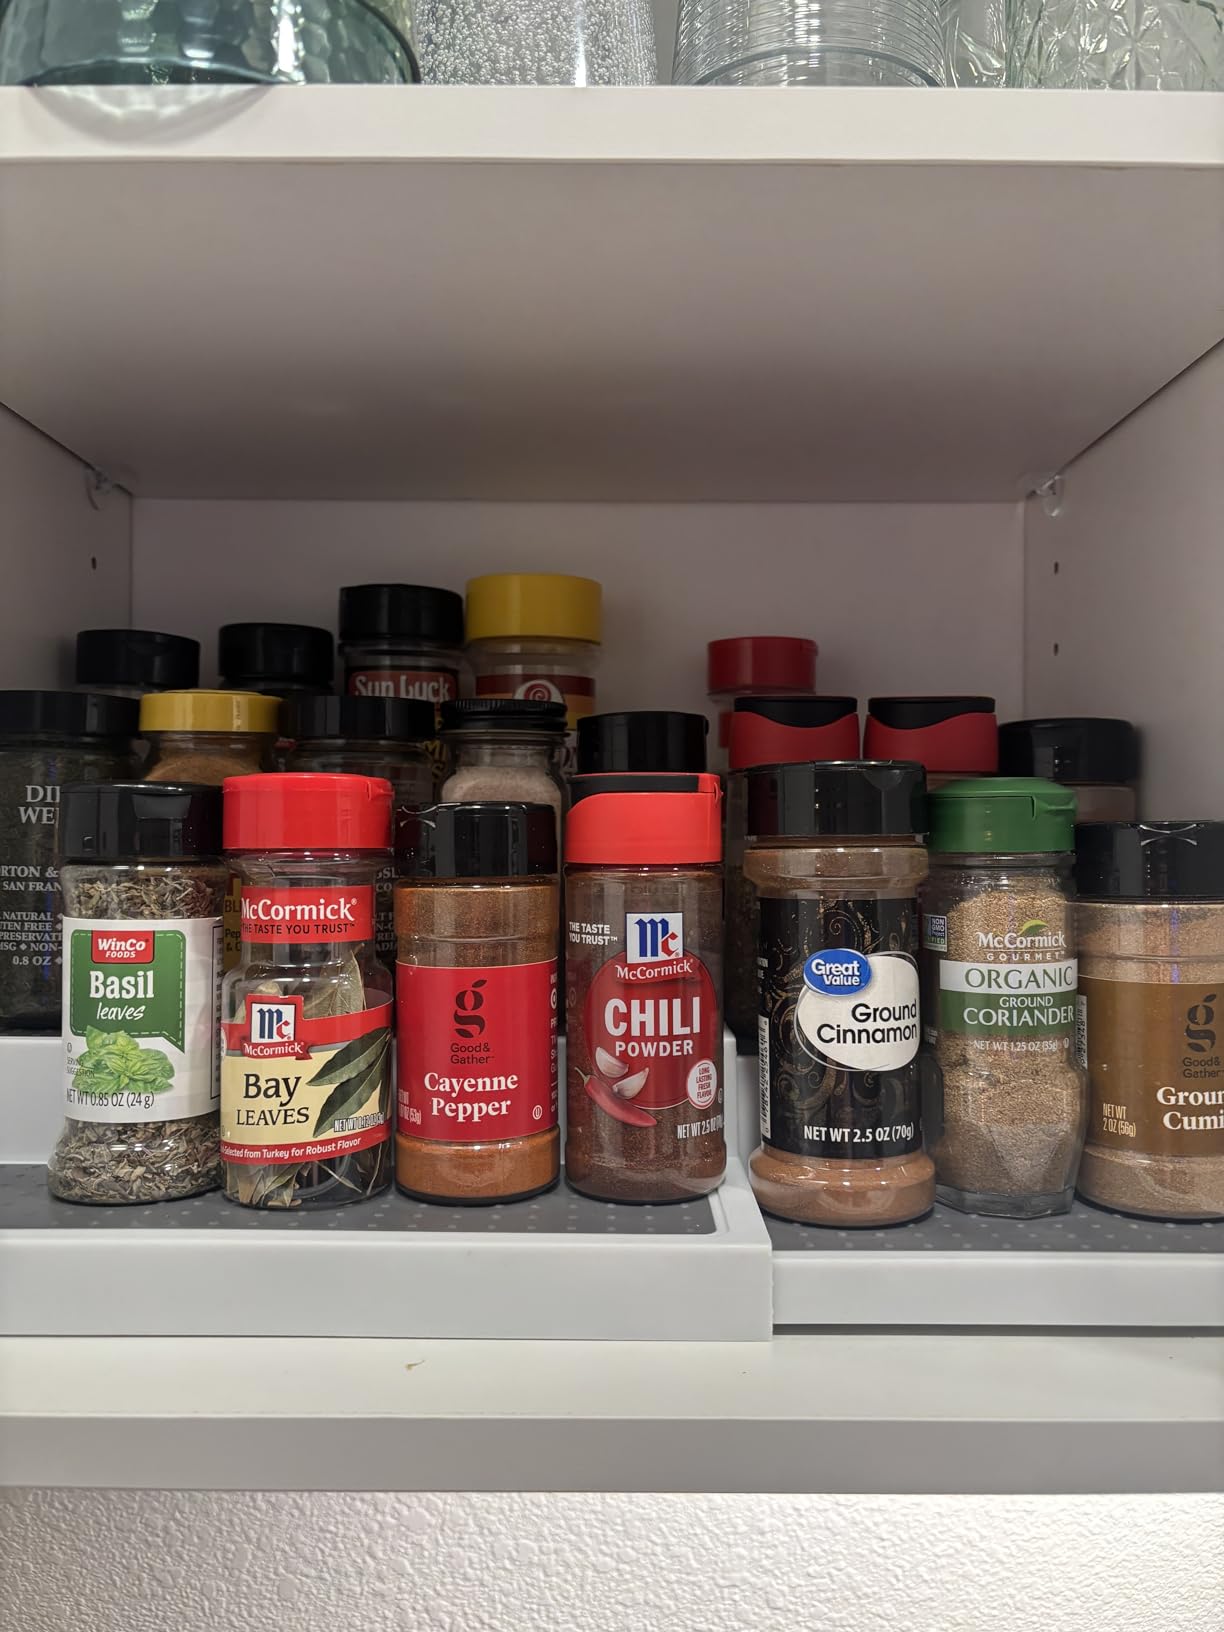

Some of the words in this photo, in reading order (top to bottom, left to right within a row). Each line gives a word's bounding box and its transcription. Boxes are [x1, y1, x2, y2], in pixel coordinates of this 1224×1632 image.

[354, 674, 395, 698] Sun
[399, 674, 451, 703] Luck
[18, 806, 60, 825] WE
[45, 866, 60, 878] &
[2, 881, 25, 891] SAN
[2, 911, 54, 921] NATURAL
[931, 918, 945, 926] NON
[23, 922, 53, 931] FREE
[254, 924, 282, 934] TASTE
[286, 924, 310, 934] YOU
[569, 922, 580, 932] THE
[581, 923, 610, 935] TASTE
[931, 924, 945, 932] GMO
[98, 938, 146, 951] WinCo
[569, 933, 581, 943] YOU
[976, 930, 1067, 948] McCormick
[12, 955, 29, 965] 0.8
[32, 956, 52, 966] OZ
[811, 958, 860, 976] Great
[89, 970, 155, 999] Basil
[822, 974, 860, 986] Value
[964, 966, 1073, 990] ORGANIC
[96, 1002, 146, 1020] leaves
[851, 999, 917, 1023] Ground
[999, 996, 1054, 1008] GROUND
[604, 997, 701, 1037] CHILI
[963, 1005, 1074, 1027] CORIANDER
[816, 1022, 918, 1044] Cinnamon
[615, 1039, 694, 1057] POWDER
[974, 1040, 990, 1050] NET
[992, 1041, 1009, 1051] WT
[1010, 1041, 1027, 1051] 1.25
[1028, 1041, 1041, 1051] OZ
[698, 1066, 710, 1075] LONG
[243, 1073, 302, 1107] Bay
[424, 1072, 518, 1098] Cayenne
[698, 1082, 711, 1091] FRESH
[77, 1090, 89, 1105] WT
[90, 1091, 109, 1107] 0.85
[111, 1092, 124, 1107] OZ
[126, 1092, 142, 1108] (24
[144, 1091, 155, 1109] g)
[236, 1106, 310, 1126] LEAVES
[431, 1097, 512, 1122] Pepper
[1102, 1103, 1115, 1118] NET
[1115, 1105, 1127, 1120] WT
[334, 1118, 346, 1132] NET
[347, 1116, 358, 1130] WT
[677, 1123, 691, 1139] NET
[690, 1121, 701, 1137] WT
[701, 1119, 710, 1135] 2.5
[803, 1125, 827, 1141] NET
[829, 1127, 850, 1142] WT
[852, 1127, 873, 1143] 2.5
[875, 1126, 890, 1141] OZ
[891, 1122, 914, 1141] (70g)
[1103, 1118, 1107, 1131] 2
[1107, 1118, 1117, 1134] OZ
[1118, 1120, 1136, 1138] (56g)
[243, 1148, 261, 1159] from
[262, 1148, 290, 1160] Turkey
[291, 1147, 304, 1156] for
[306, 1141, 336, 1155] Robust
[337, 1137, 362, 1150] Flavor
